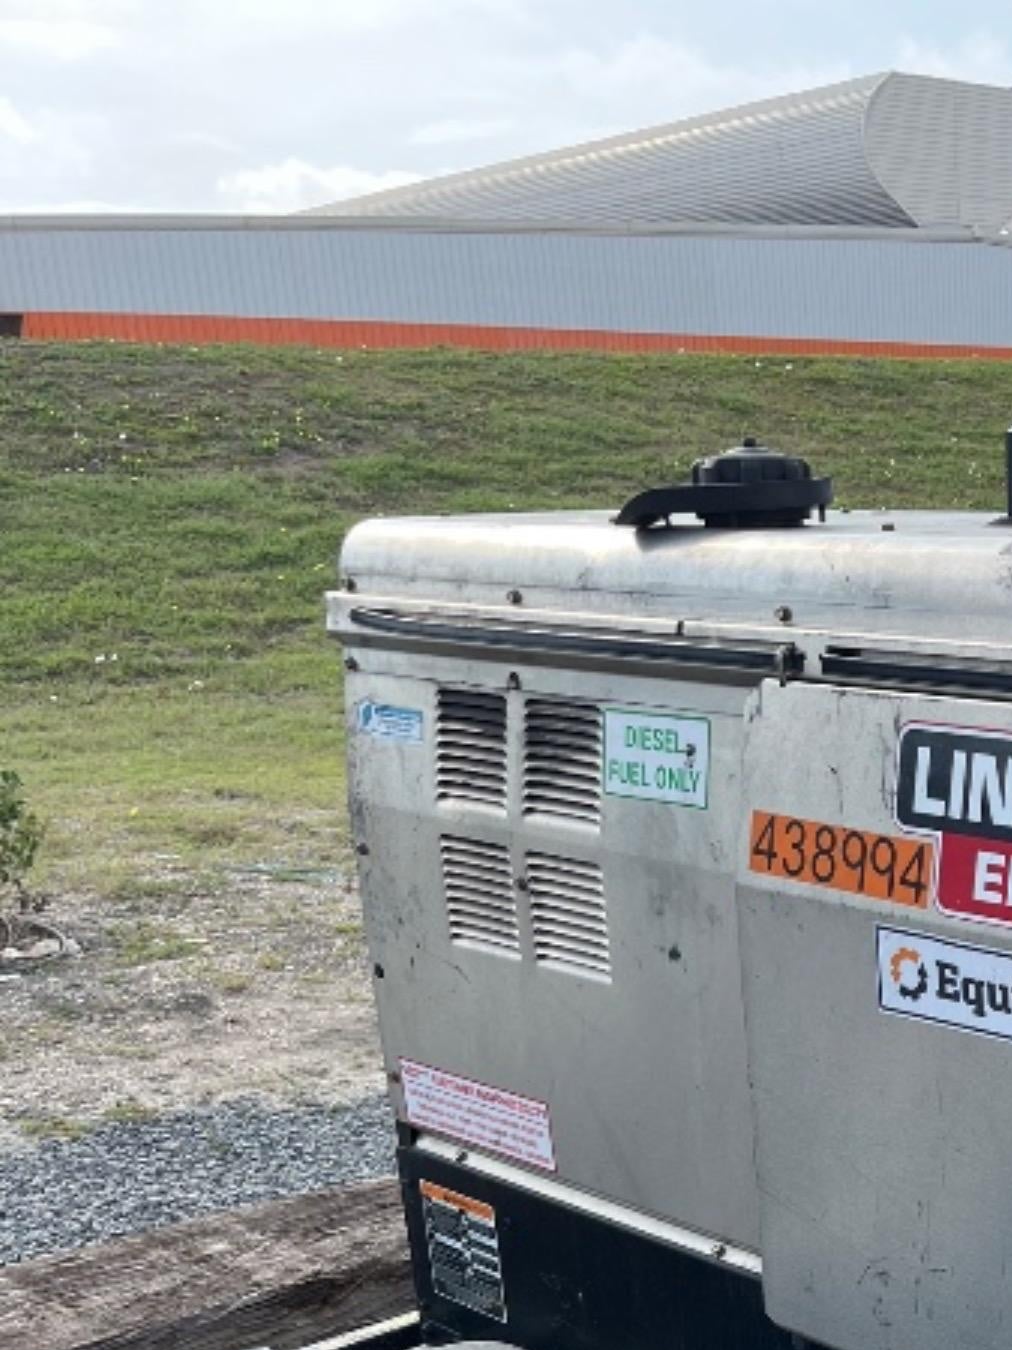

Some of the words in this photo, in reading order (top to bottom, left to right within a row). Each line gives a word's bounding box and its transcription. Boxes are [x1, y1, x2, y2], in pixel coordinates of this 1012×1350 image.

[624, 725, 684, 753] DIESEL
[608, 757, 652, 786] FUEL
[655, 768, 700, 794] ONLY
[753, 814, 930, 903] 438994
